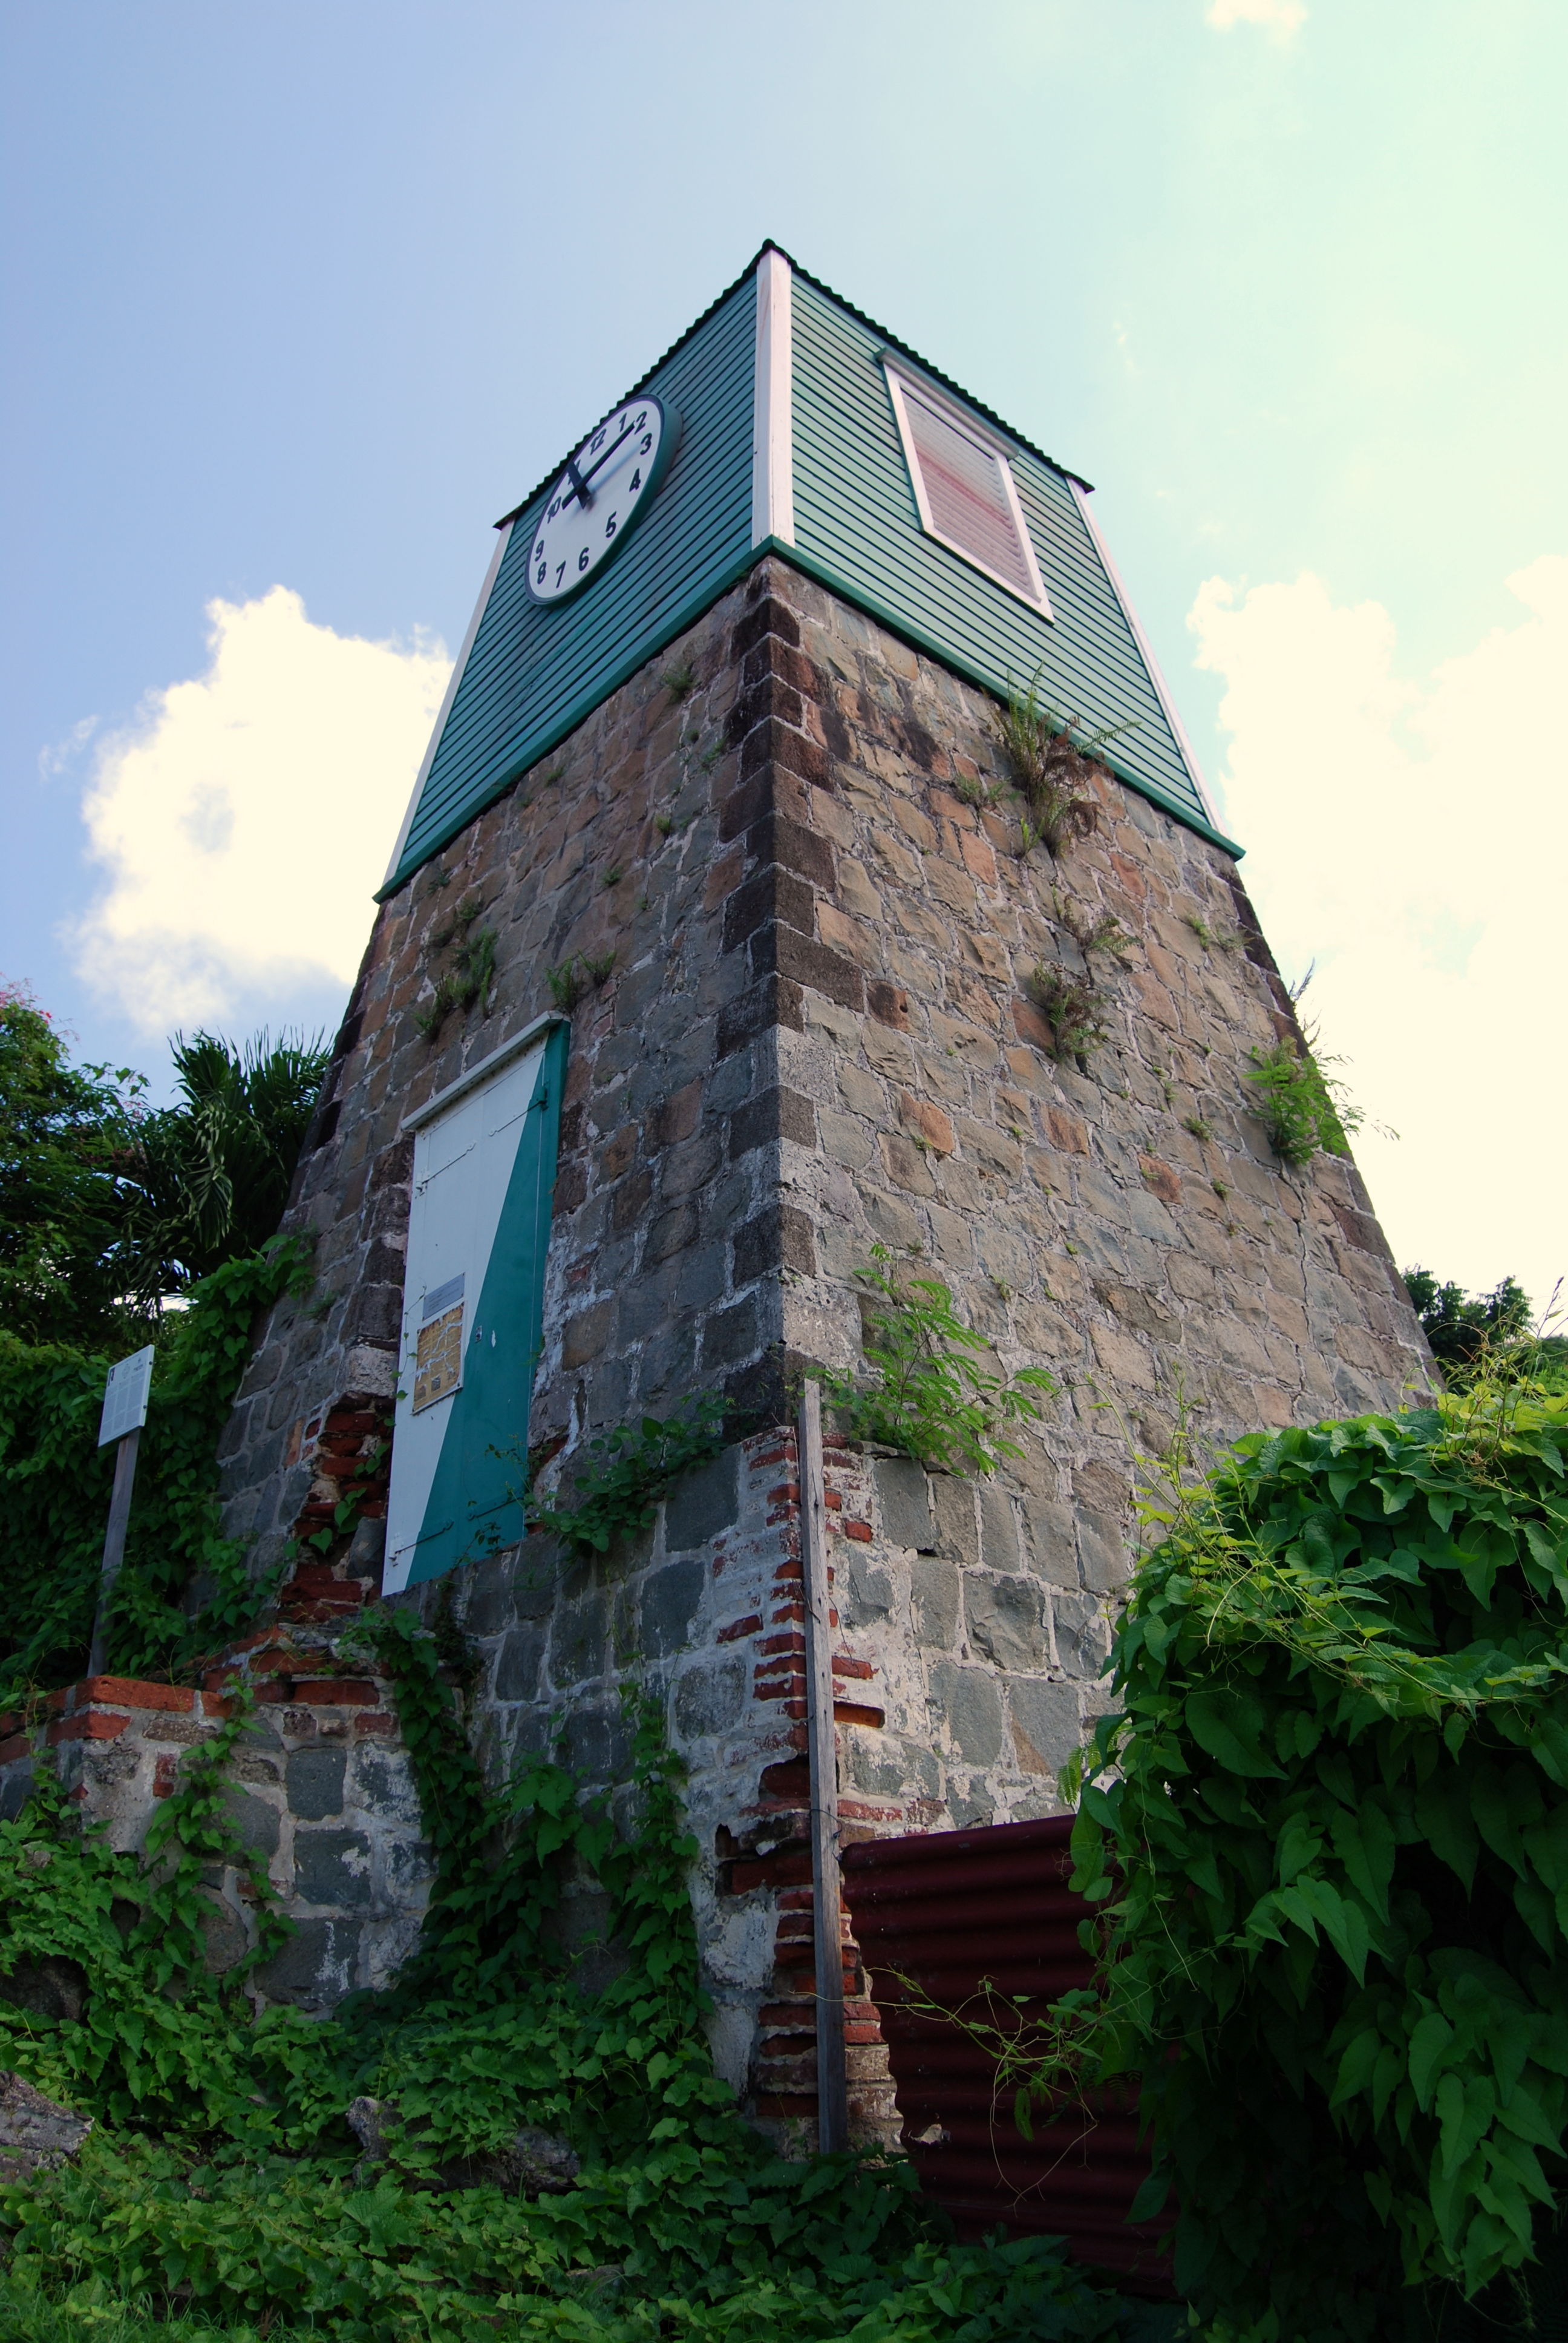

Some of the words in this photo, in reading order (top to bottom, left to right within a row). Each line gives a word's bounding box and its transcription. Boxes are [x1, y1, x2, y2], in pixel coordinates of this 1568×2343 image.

[619, 413, 627, 432] 1
[634, 411, 647, 435] 2
[590, 428, 606, 456] 12
[640, 433, 653, 455] 3
[629, 468, 641, 492] 4
[547, 496, 561, 524] 10
[606, 511, 617, 538] 5
[535, 540, 544, 562] 9
[578, 547, 589, 571] 6
[537, 562, 547, 585] 8
[556, 560, 566, 588] 7
